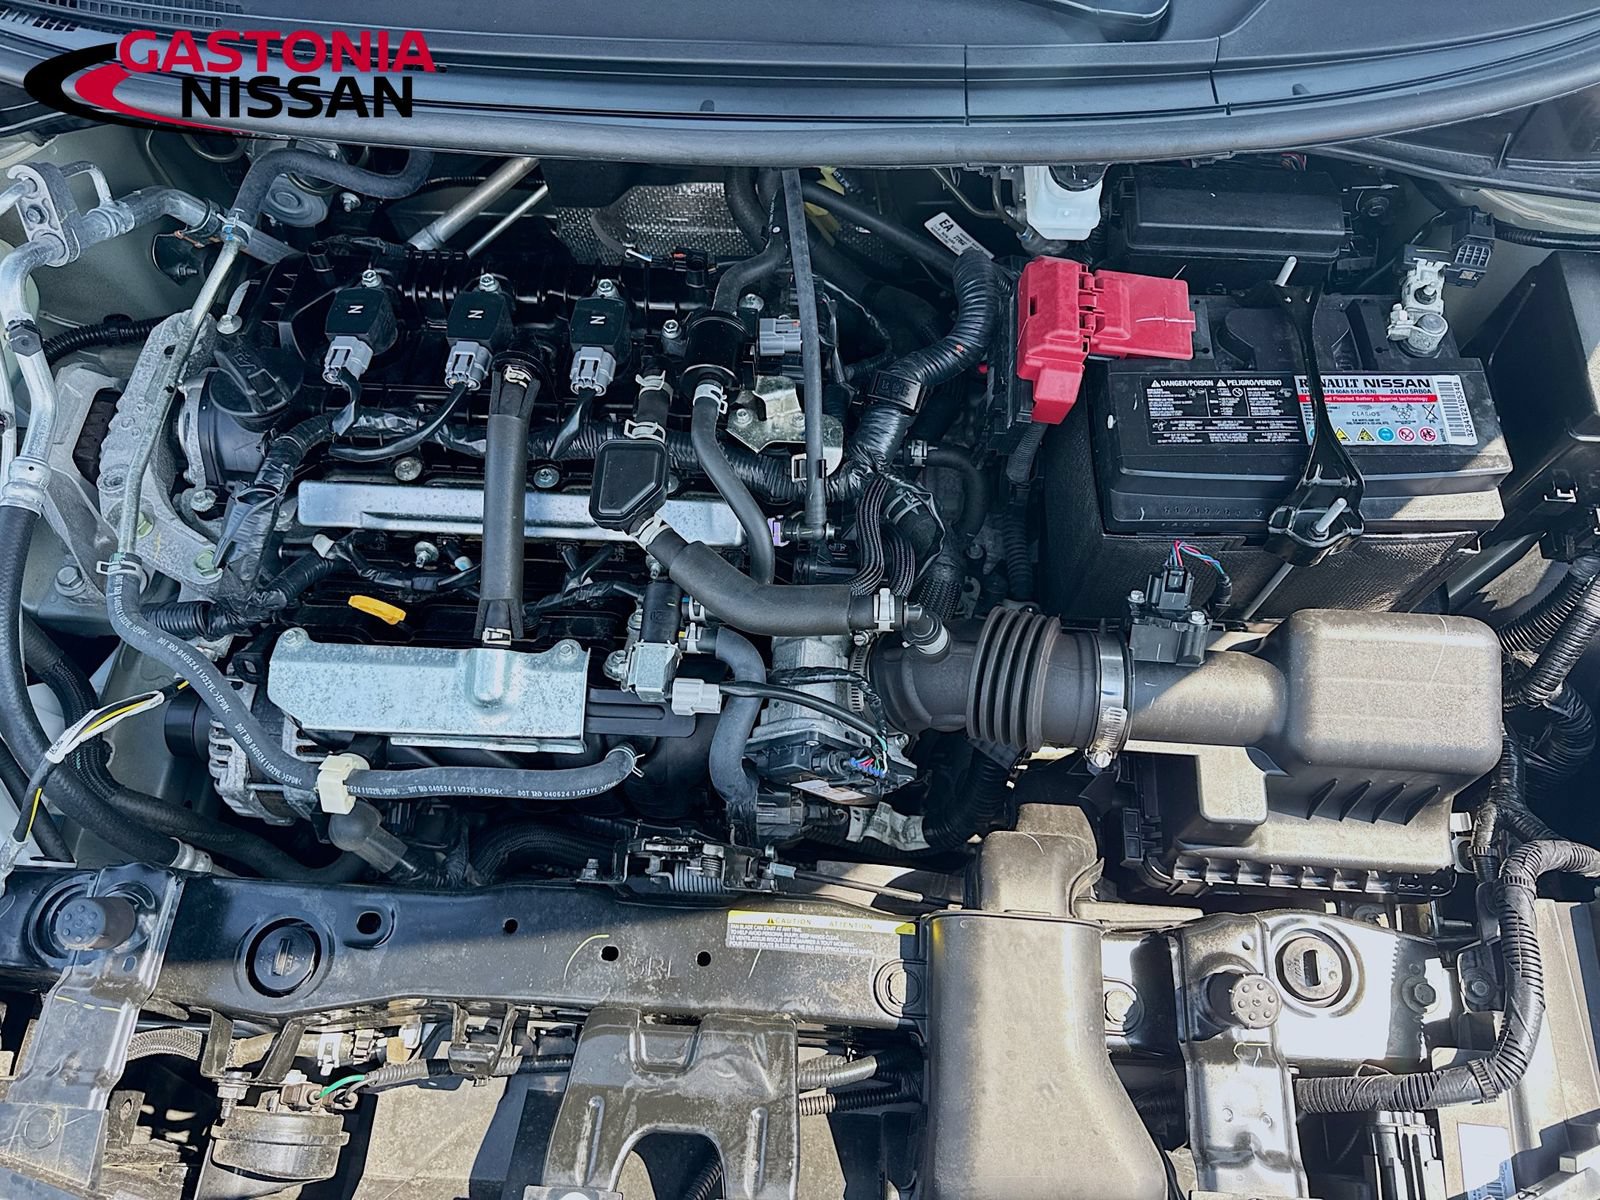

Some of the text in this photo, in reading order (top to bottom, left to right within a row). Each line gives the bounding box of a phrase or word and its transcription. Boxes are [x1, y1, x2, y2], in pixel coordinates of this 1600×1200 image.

[939, 219, 954, 232] EA
[1299, 379, 1430, 388] RNAULT NISSAN
